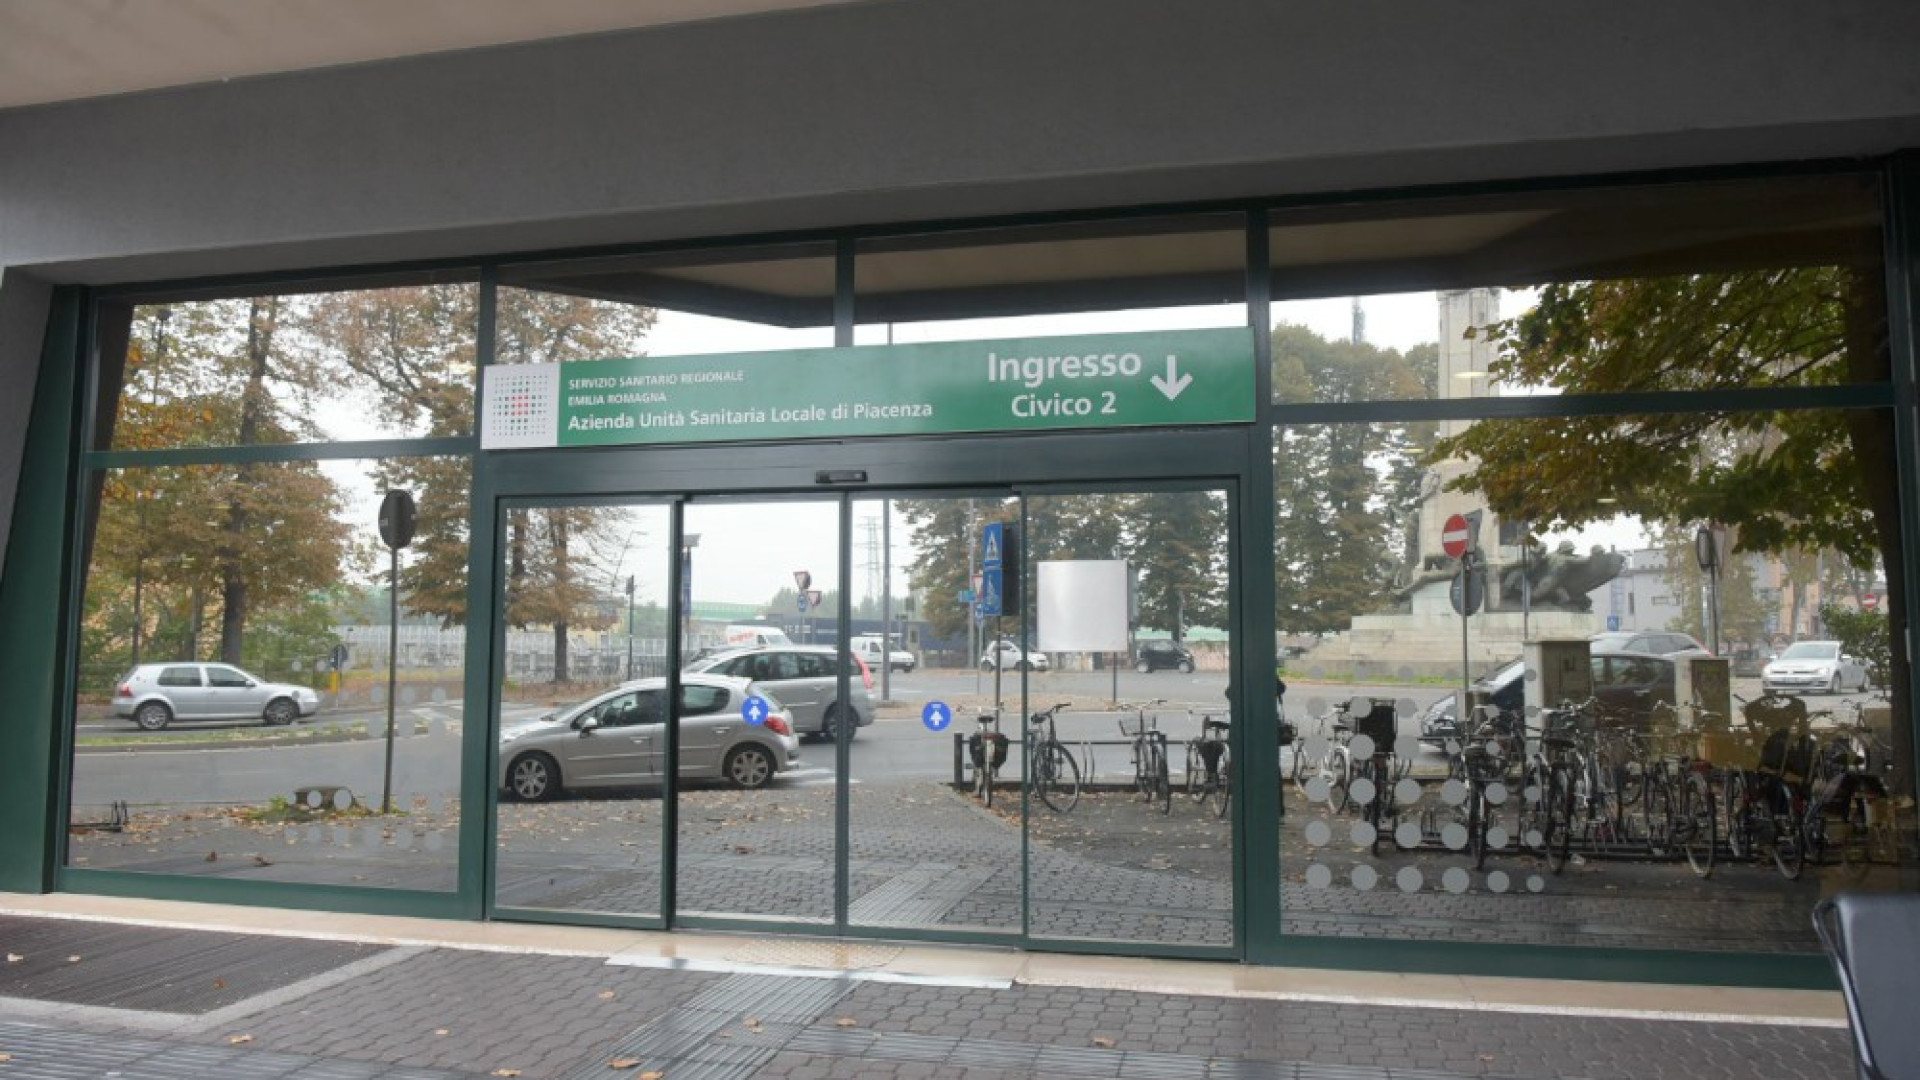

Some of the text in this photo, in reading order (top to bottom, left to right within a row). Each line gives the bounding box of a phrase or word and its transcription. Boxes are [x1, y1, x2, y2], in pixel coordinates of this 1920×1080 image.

[568, 370, 744, 390] SERVIZIO SANITARIO REGIONALE
[988, 352, 1141, 388] Ingresso
[568, 392, 667, 406] EMILIA ROMAGNA
[1011, 391, 1117, 417] Civico 2
[568, 402, 933, 430] Azienda Unità Sanitaria Locale di Piacenza
